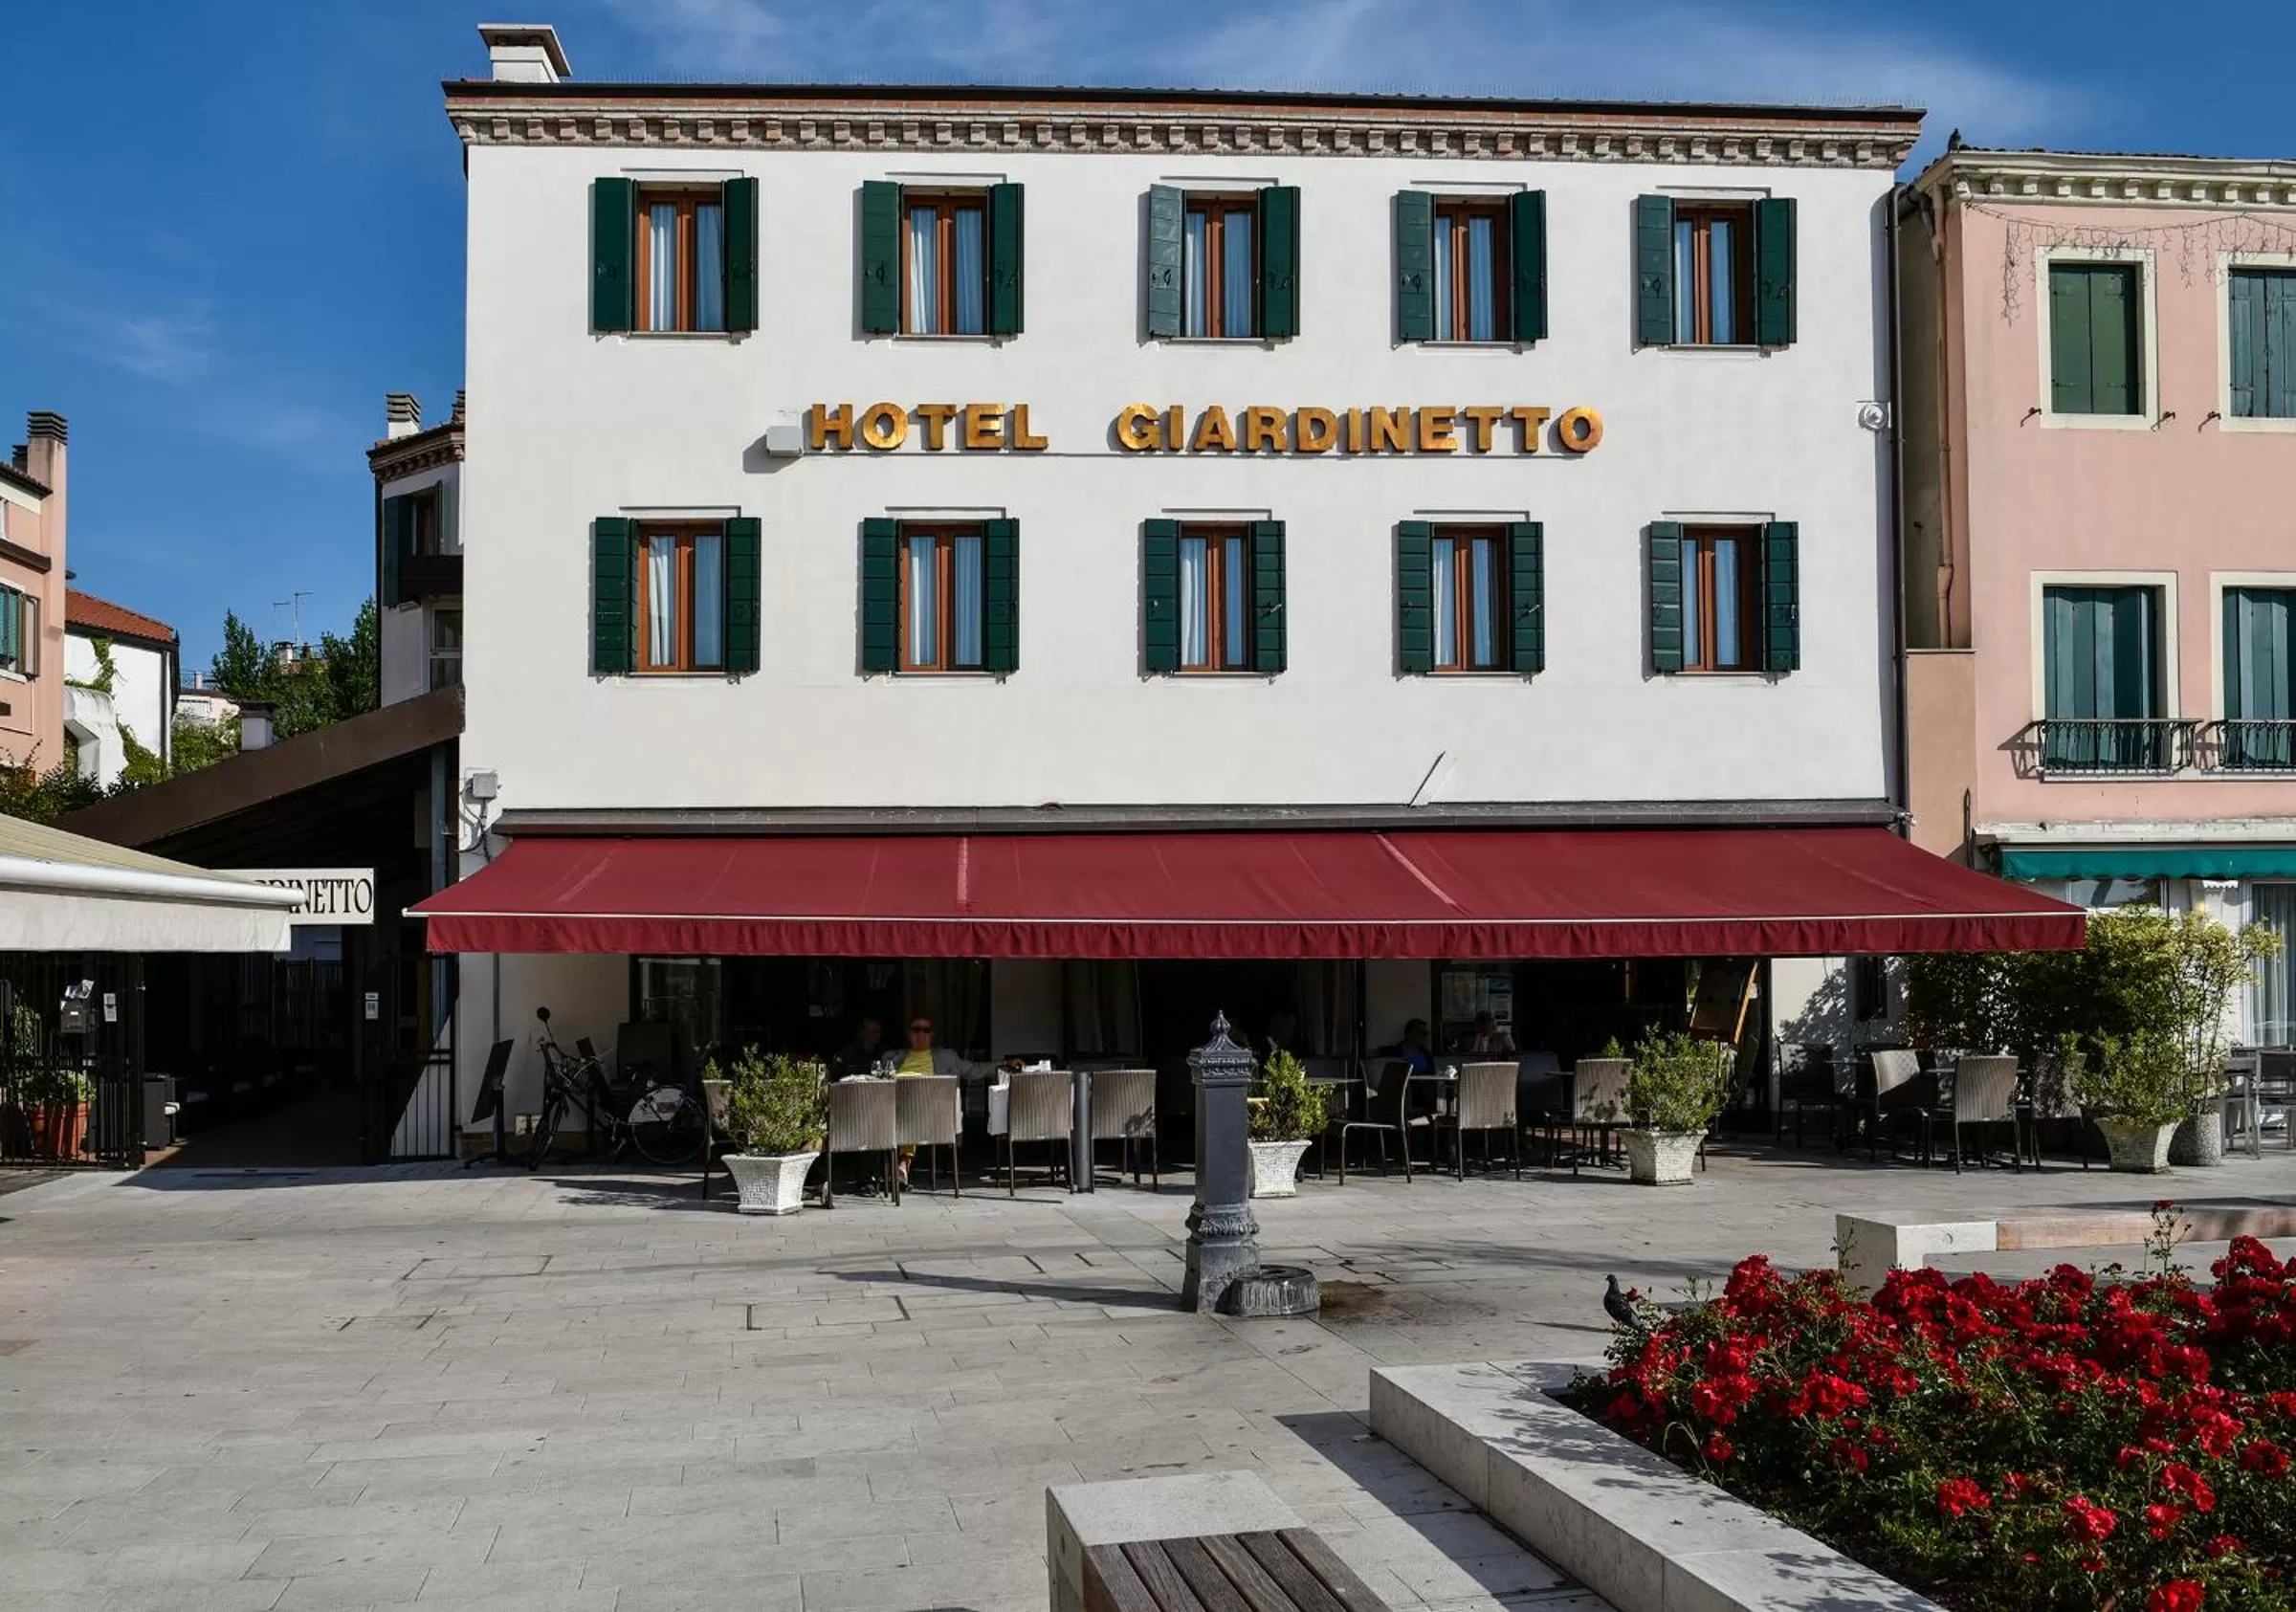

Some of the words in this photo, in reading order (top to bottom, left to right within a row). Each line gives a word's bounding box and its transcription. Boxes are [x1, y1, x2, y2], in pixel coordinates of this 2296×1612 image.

[811, 403, 1049, 450] HOTEL
[1115, 403, 1603, 453] GIARDINETTO
[254, 878, 372, 914] NETTO
